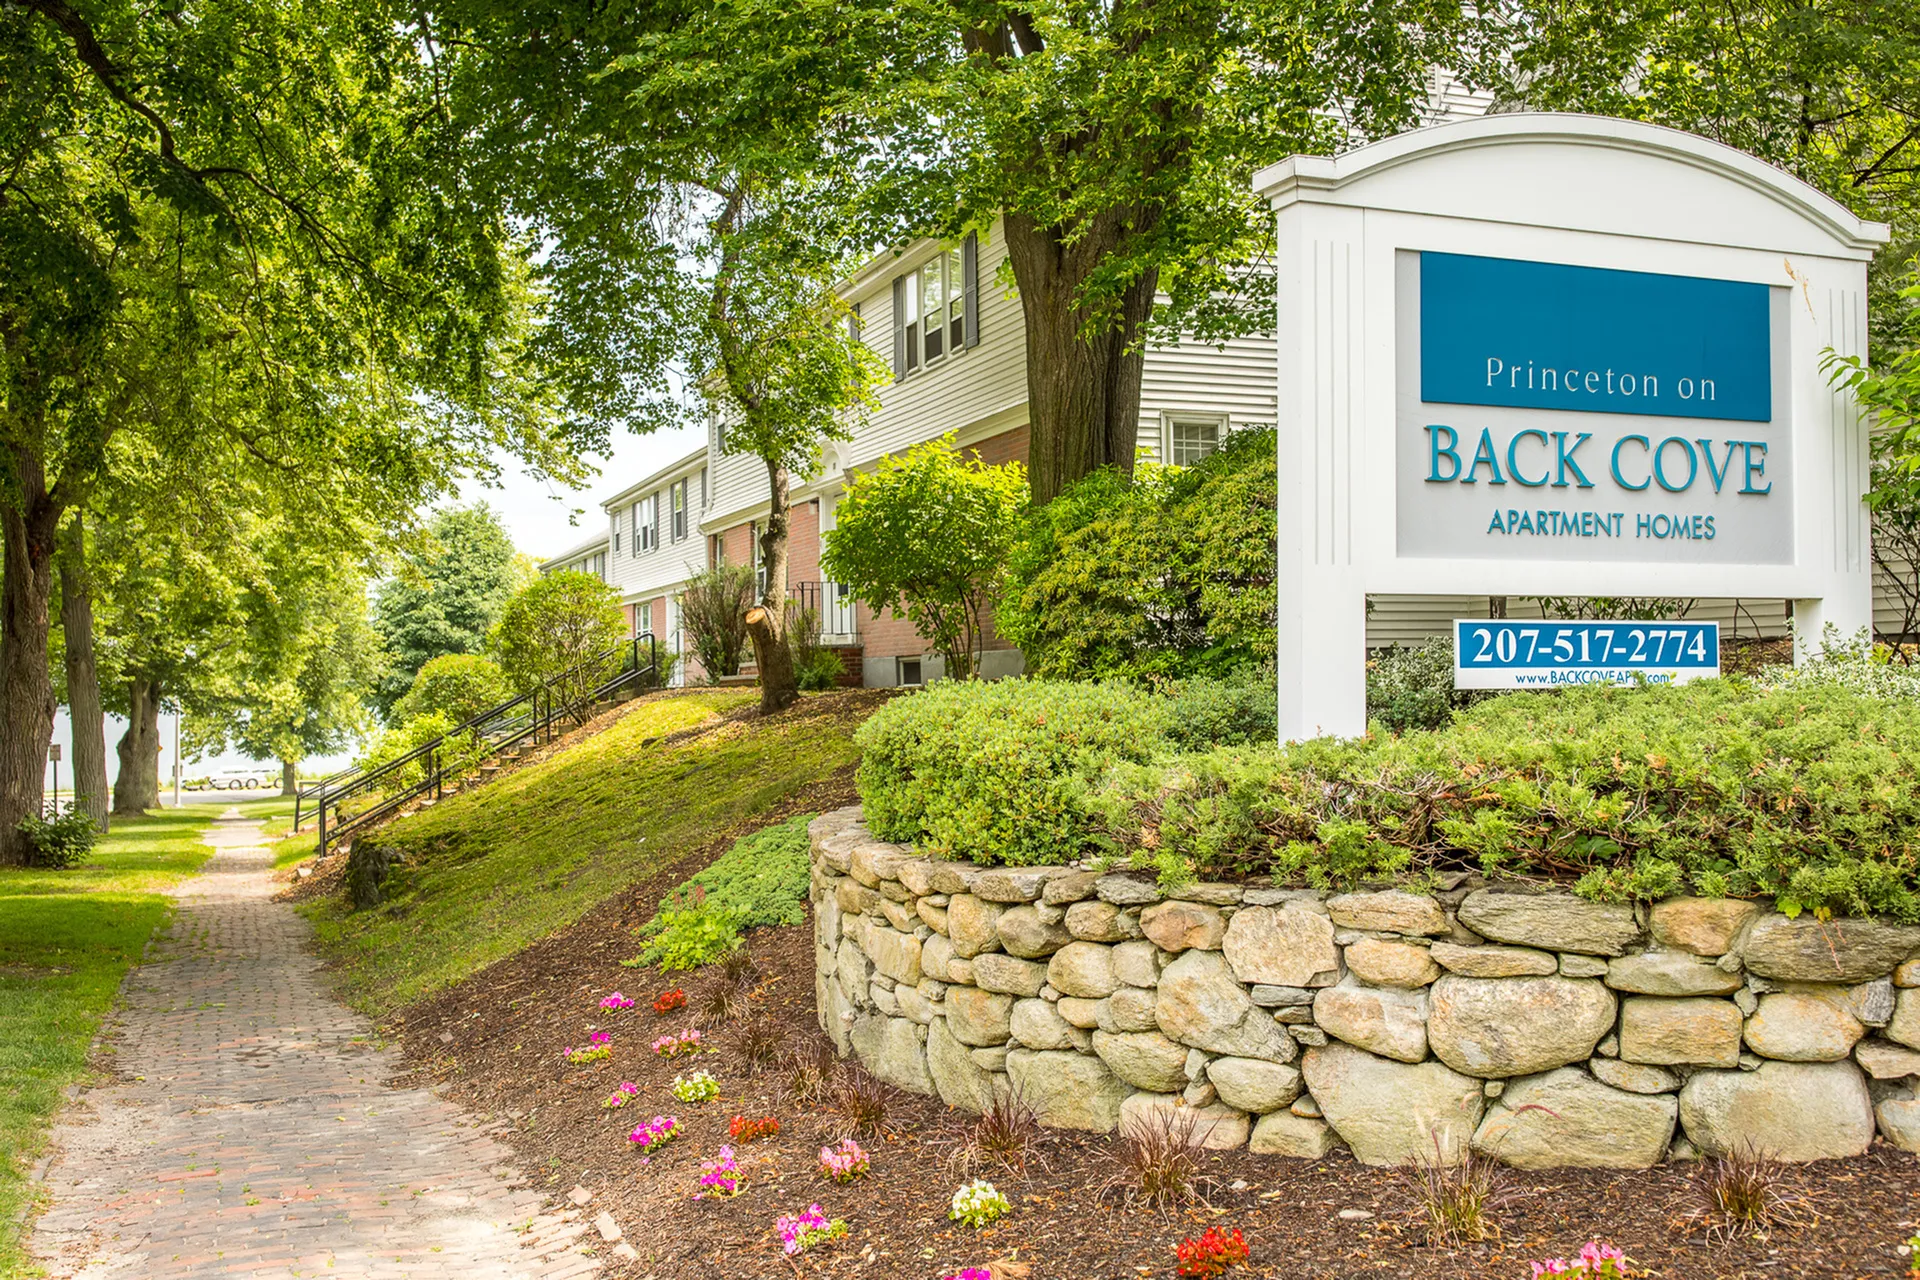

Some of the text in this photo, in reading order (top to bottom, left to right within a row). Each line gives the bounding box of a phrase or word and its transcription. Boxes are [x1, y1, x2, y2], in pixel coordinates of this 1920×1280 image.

[1486, 357, 1715, 401] Princeton on
[1424, 424, 1773, 495] BACK COVE
[1487, 510, 1716, 540] APARTMENT HOMES
[1472, 628, 1707, 663] 207-517-2774
[1515, 670, 1669, 684] www.BACKCOVEAPcom
